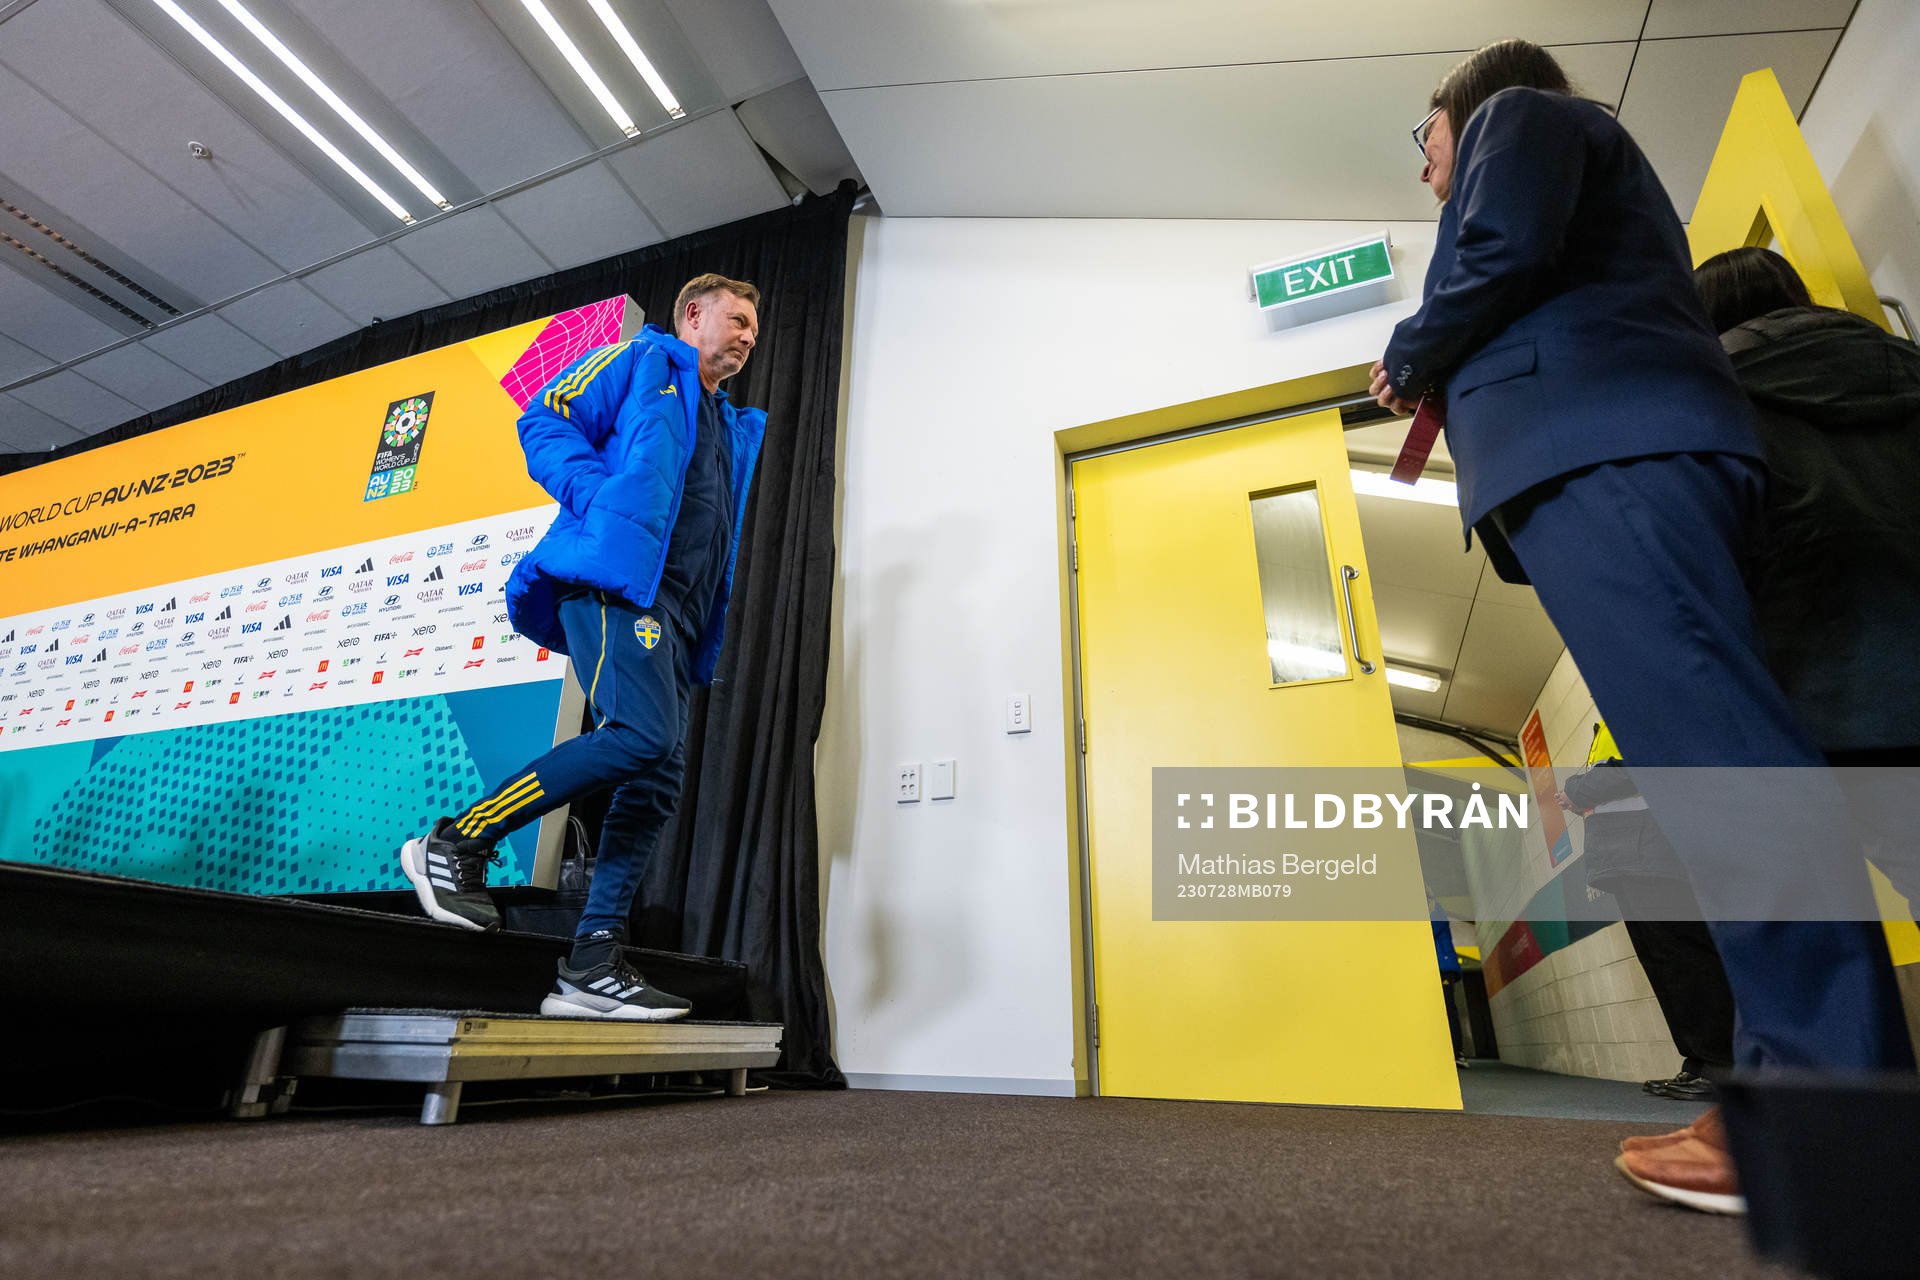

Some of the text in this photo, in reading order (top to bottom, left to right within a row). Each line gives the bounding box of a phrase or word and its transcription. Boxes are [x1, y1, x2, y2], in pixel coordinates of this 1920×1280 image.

[1284, 255, 1356, 296] EXIT
[376, 453, 406, 465] WOMEN'S
[377, 450, 392, 460] FIFA
[374, 457, 411, 472] WORLD CUP
[369, 473, 390, 487] AU
[393, 468, 414, 482] 20
[367, 484, 388, 499] NZ
[390, 479, 412, 494] 23
[0, 502, 62, 532] WORLD
[63, 491, 102, 516] CUP
[19, 504, 196, 559] WHANGANUI-A-TARA
[506, 526, 534, 539] QATAR
[465, 544, 491, 553] HYUNDAI
[286, 571, 309, 583] QATAR
[321, 565, 342, 578] VISA
[348, 580, 374, 591] QATAR
[387, 573, 409, 586] VISA
[417, 588, 444, 600] QATAR
[458, 582, 483, 596] VISA
[106, 608, 126, 618] QATAR
[136, 603, 154, 615] VISA
[378, 604, 402, 613] HYUNDAI
[154, 617, 175, 627] QATAR
[185, 612, 205, 624] VISA
[492, 612, 510, 624] xe
[208, 626, 230, 638] QATAR
[242, 622, 262, 634] VISA
[411, 624, 437, 637] xero
[337, 636, 360, 649] xero
[20, 644, 37, 655] VISA
[267, 648, 289, 660] xero
[65, 654, 83, 665] VISA
[201, 659, 222, 671] xero
[140, 670, 159, 680] xero
[81, 679, 101, 690] xero
